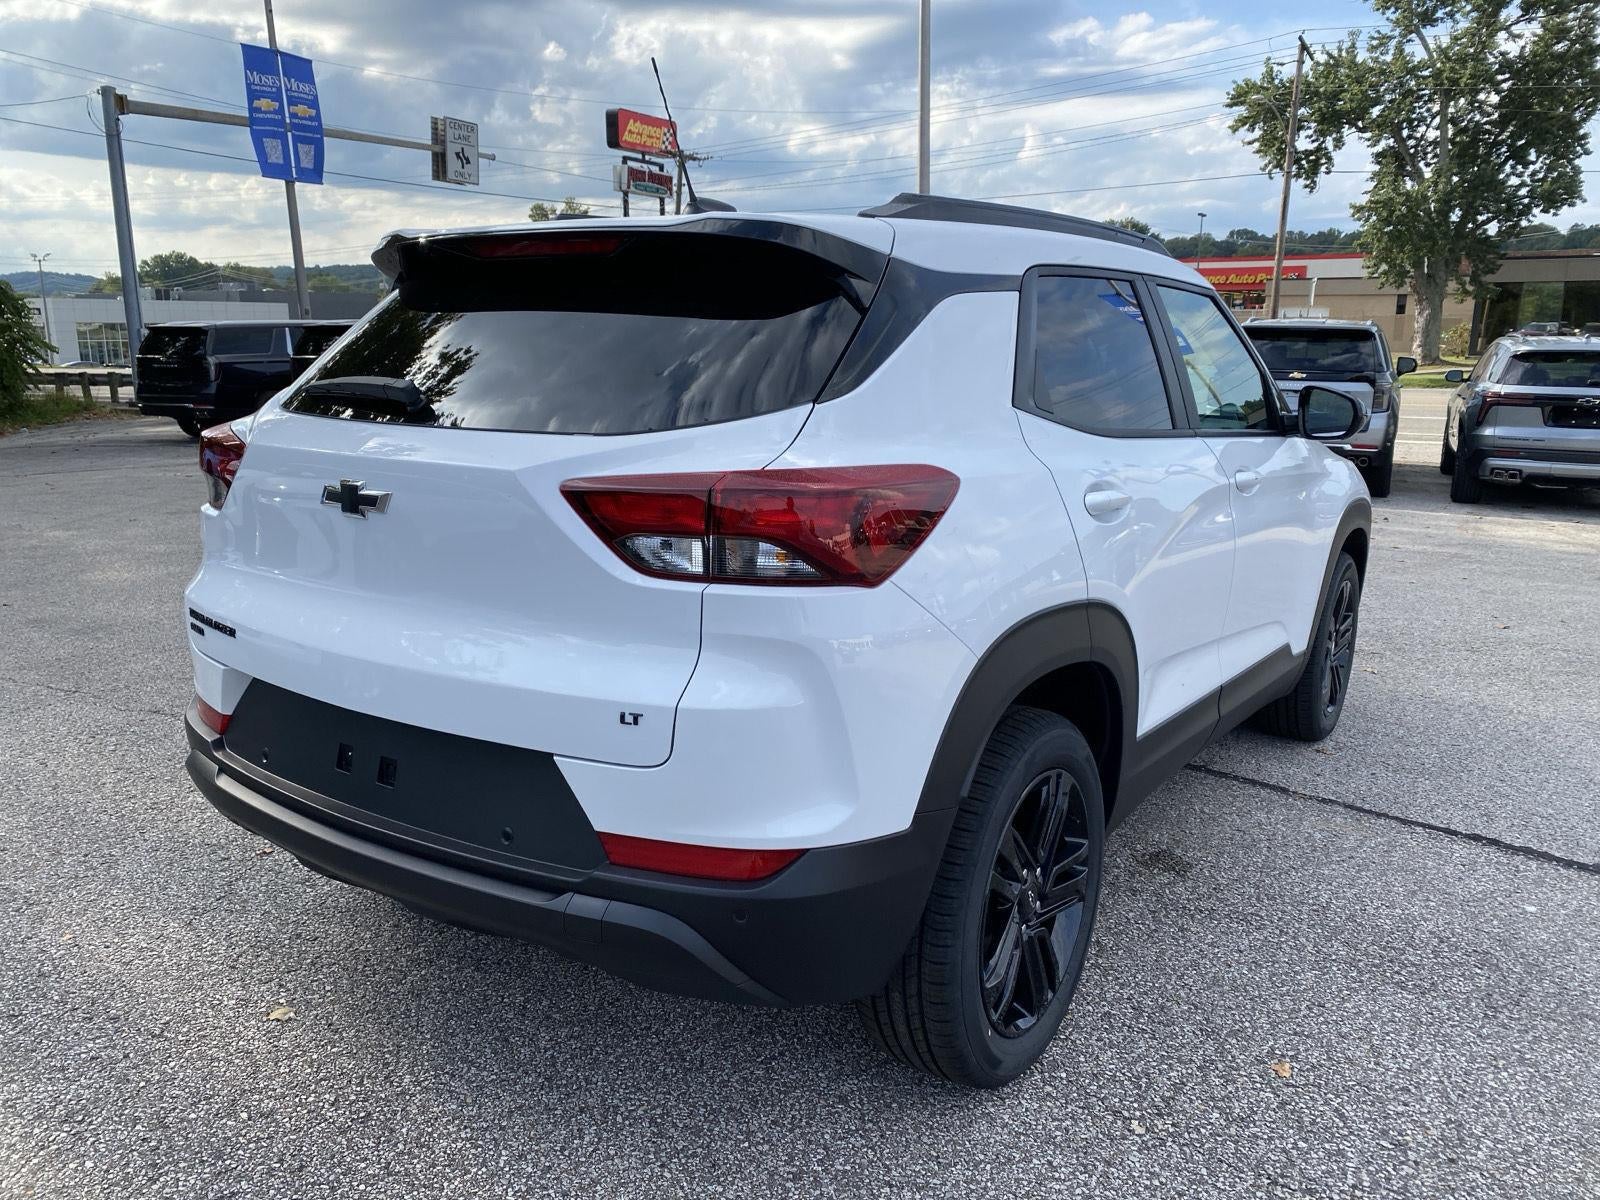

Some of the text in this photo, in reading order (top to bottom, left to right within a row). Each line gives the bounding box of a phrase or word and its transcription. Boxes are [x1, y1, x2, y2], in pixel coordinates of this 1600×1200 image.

[449, 121, 475, 133] CENTER
[627, 118, 661, 137] Advance
[453, 133, 471, 143] LANE
[622, 131, 660, 148] Auto Parts
[454, 170, 472, 179] ONLY
[1227, 273, 1255, 284] Auto
[620, 711, 643, 725] LT
